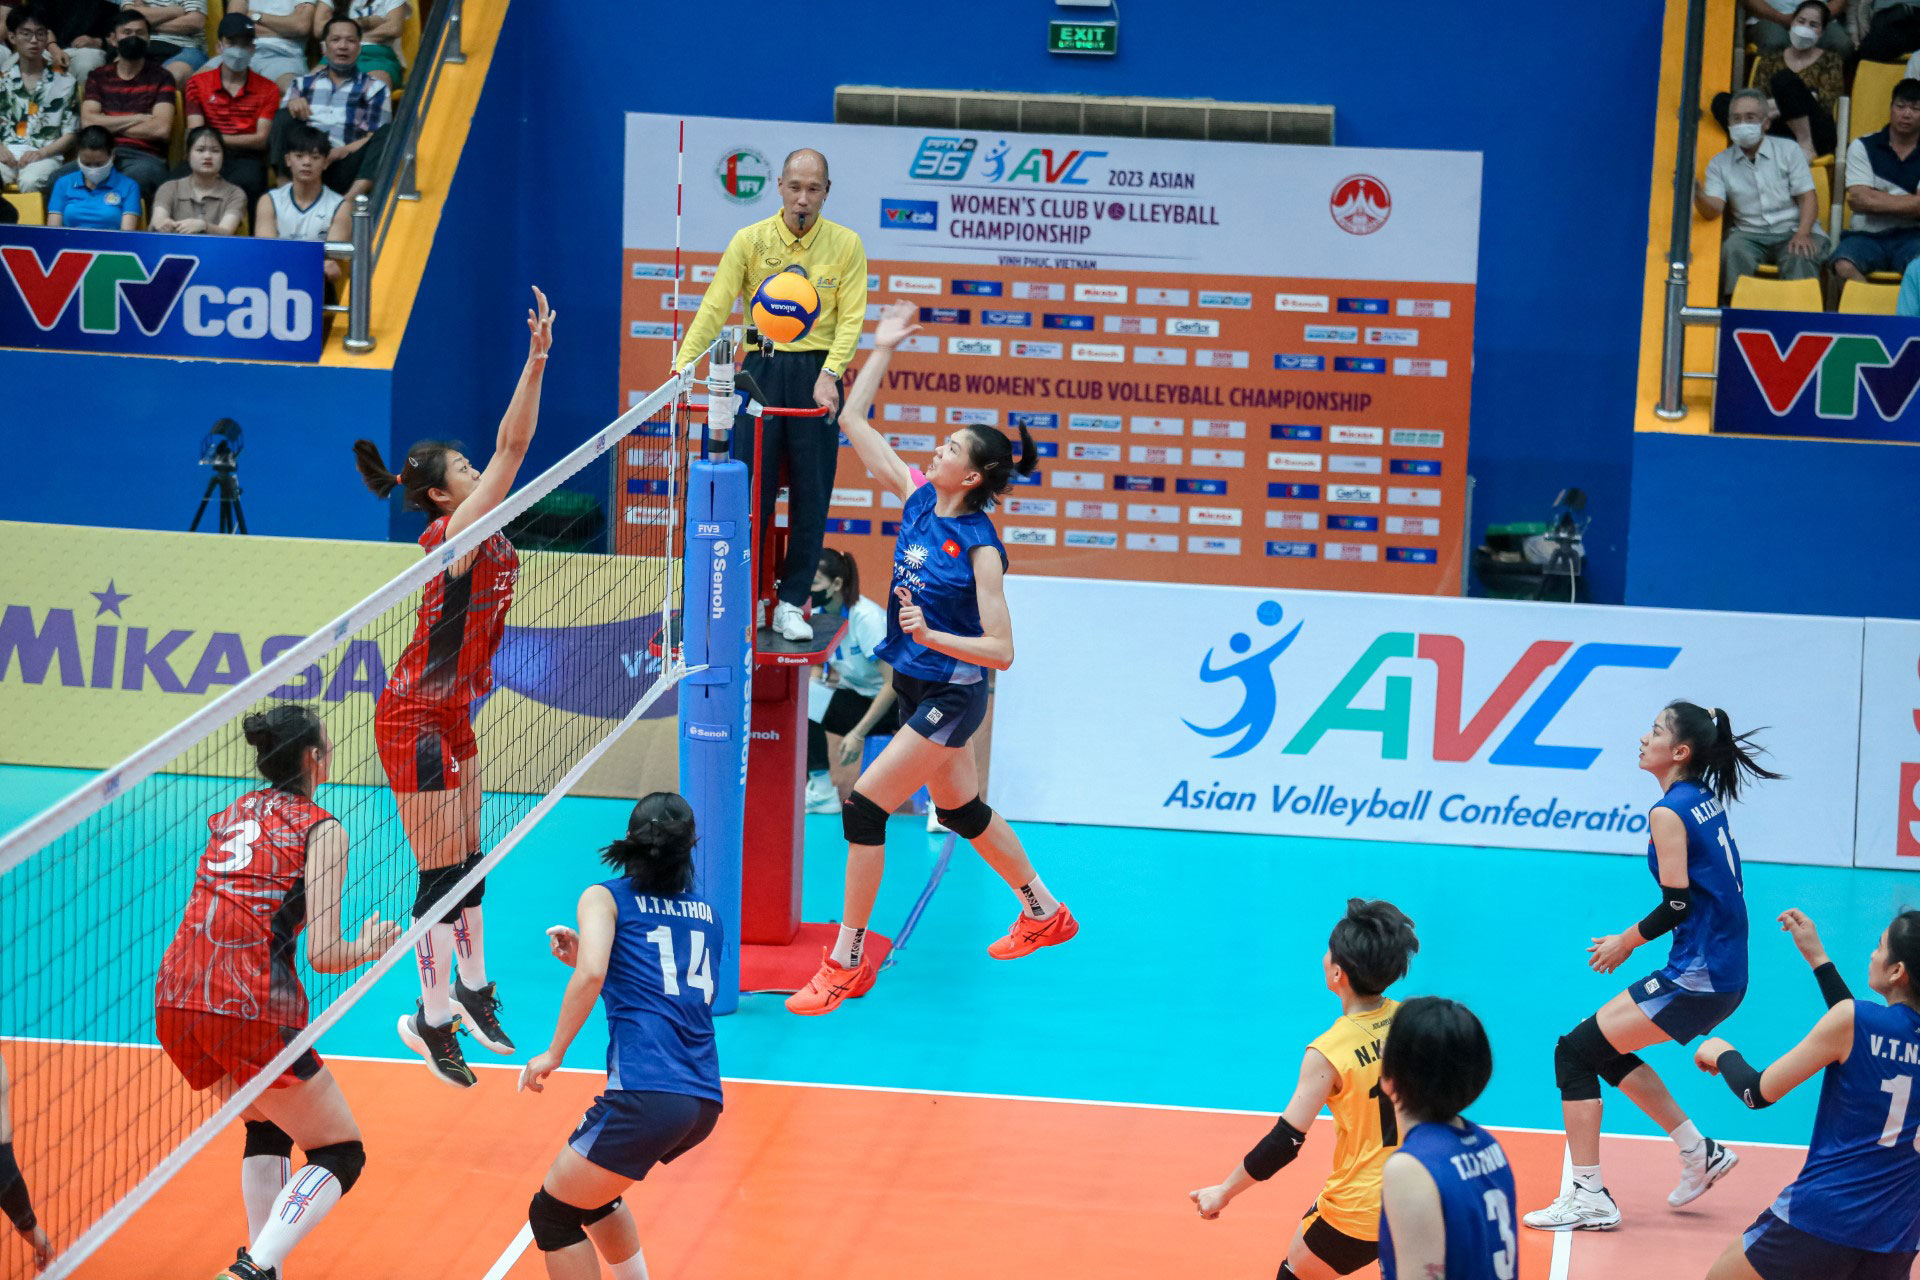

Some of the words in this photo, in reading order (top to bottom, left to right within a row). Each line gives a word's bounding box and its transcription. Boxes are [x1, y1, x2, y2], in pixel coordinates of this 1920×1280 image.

[1060, 28, 1106, 41] EXIT
[915, 151, 967, 176] 36
[1007, 148, 1109, 185] AVC
[1108, 169, 1144, 188] 2023
[1149, 171, 1195, 190] ASIAN
[950, 194, 1035, 217] WOMEN'S
[1041, 198, 1088, 219] CLUB
[950, 220, 1091, 245] CHAMPIONSHIP
[888, 371, 961, 392] VTVCAB
[966, 374, 1050, 397] WOMEN'S
[1055, 378, 1102, 399] CLUB
[1107, 382, 1224, 407] VOLLEYBALL
[1229, 387, 1372, 412] CHAMPIONSHIP
[712, 558, 727, 619] Senoh
[0, 604, 389, 703] MIKASA
[1282, 632, 1683, 771] AVC
[698, 728, 728, 738] Senoh
[750, 730, 780, 741] noh
[1163, 779, 1256, 812] Asian
[1269, 782, 1431, 827] Volleyball
[1438, 793, 1651, 836] Confederatio
[207, 819, 262, 872] 3
[634, 895, 713, 924] V.T.K.THOA
[646, 925, 714, 1006] 14
[1877, 1074, 1920, 1154] 1
[1483, 1189, 1515, 1280] 3
